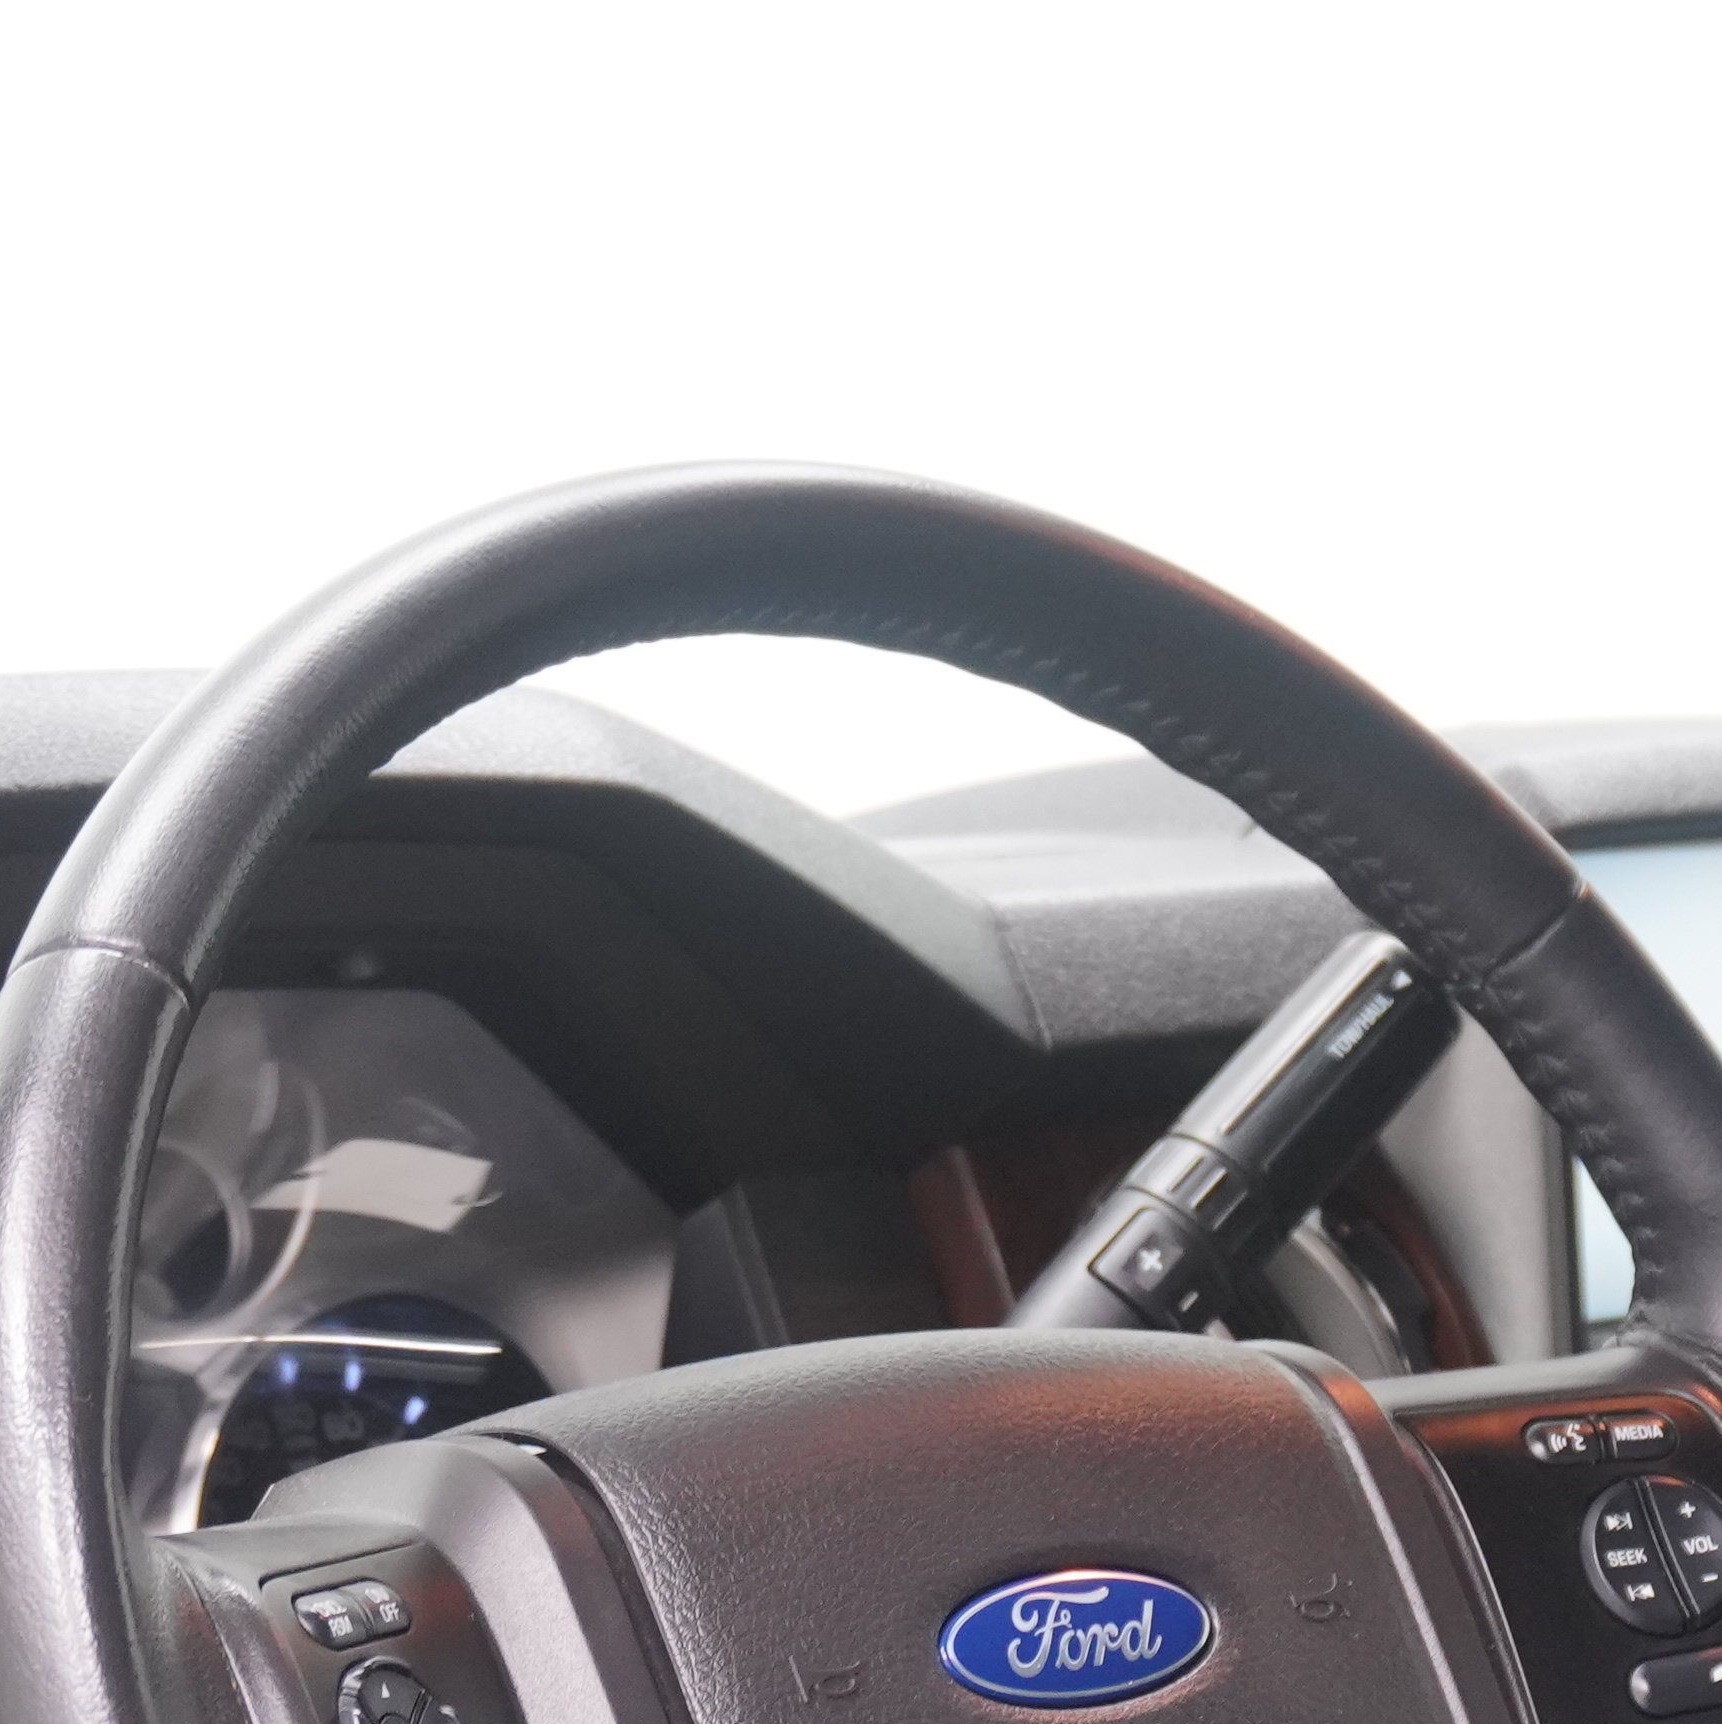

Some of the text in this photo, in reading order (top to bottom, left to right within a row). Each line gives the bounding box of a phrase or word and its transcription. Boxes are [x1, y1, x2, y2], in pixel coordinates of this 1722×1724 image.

[1614, 1423, 1664, 1441] MEDIA
[1683, 1534, 1719, 1555] VOL
[1606, 1547, 1648, 1567] SEEK
[1006, 1585, 1163, 1679] Ford
